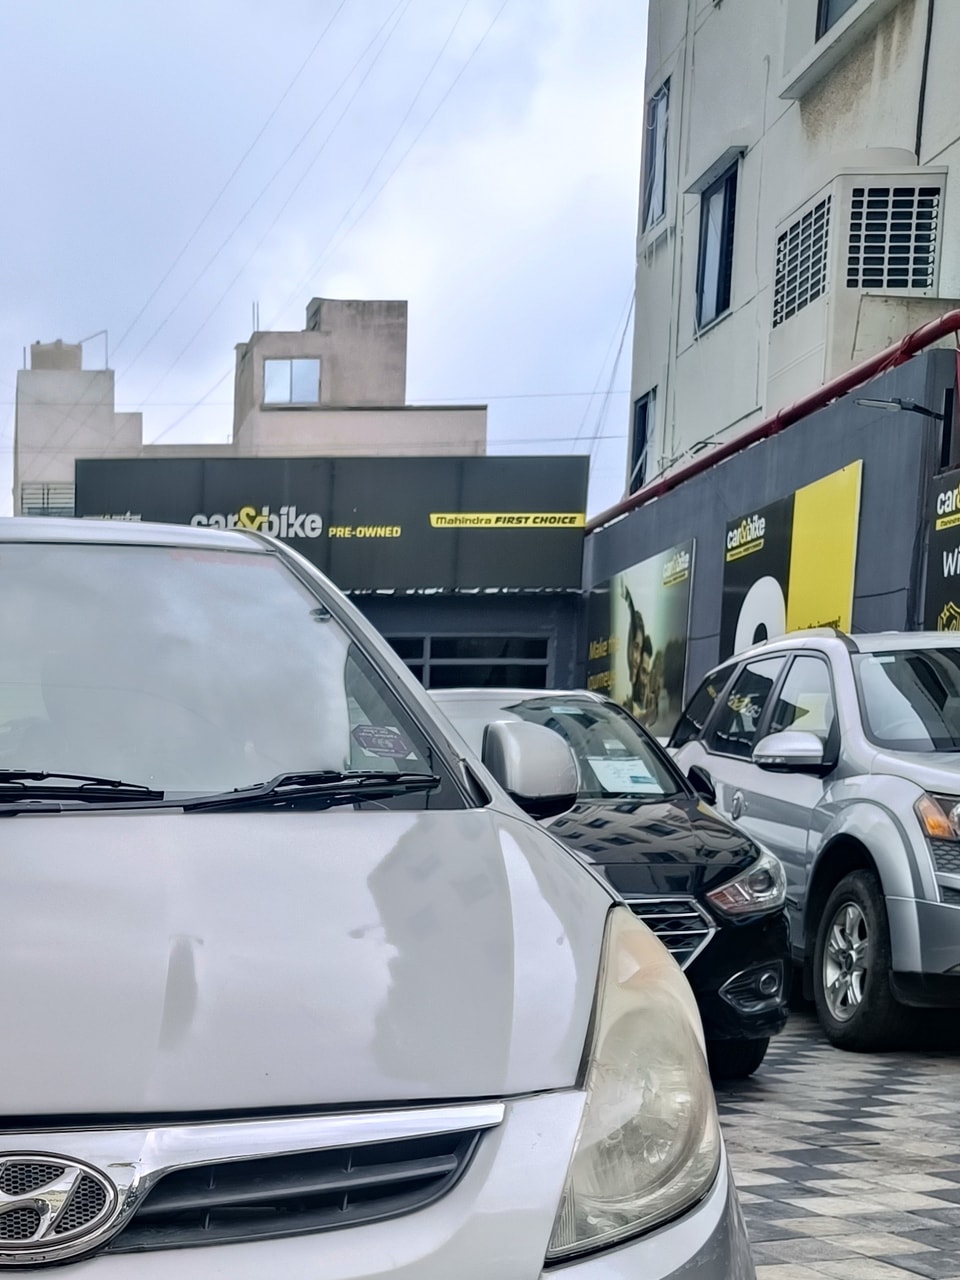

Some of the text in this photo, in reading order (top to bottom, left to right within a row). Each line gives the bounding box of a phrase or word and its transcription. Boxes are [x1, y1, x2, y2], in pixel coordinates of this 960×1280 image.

[436, 515, 577, 525] Mahindra FIRST CHOICE
[328, 526, 402, 538] PRE-OWNED
